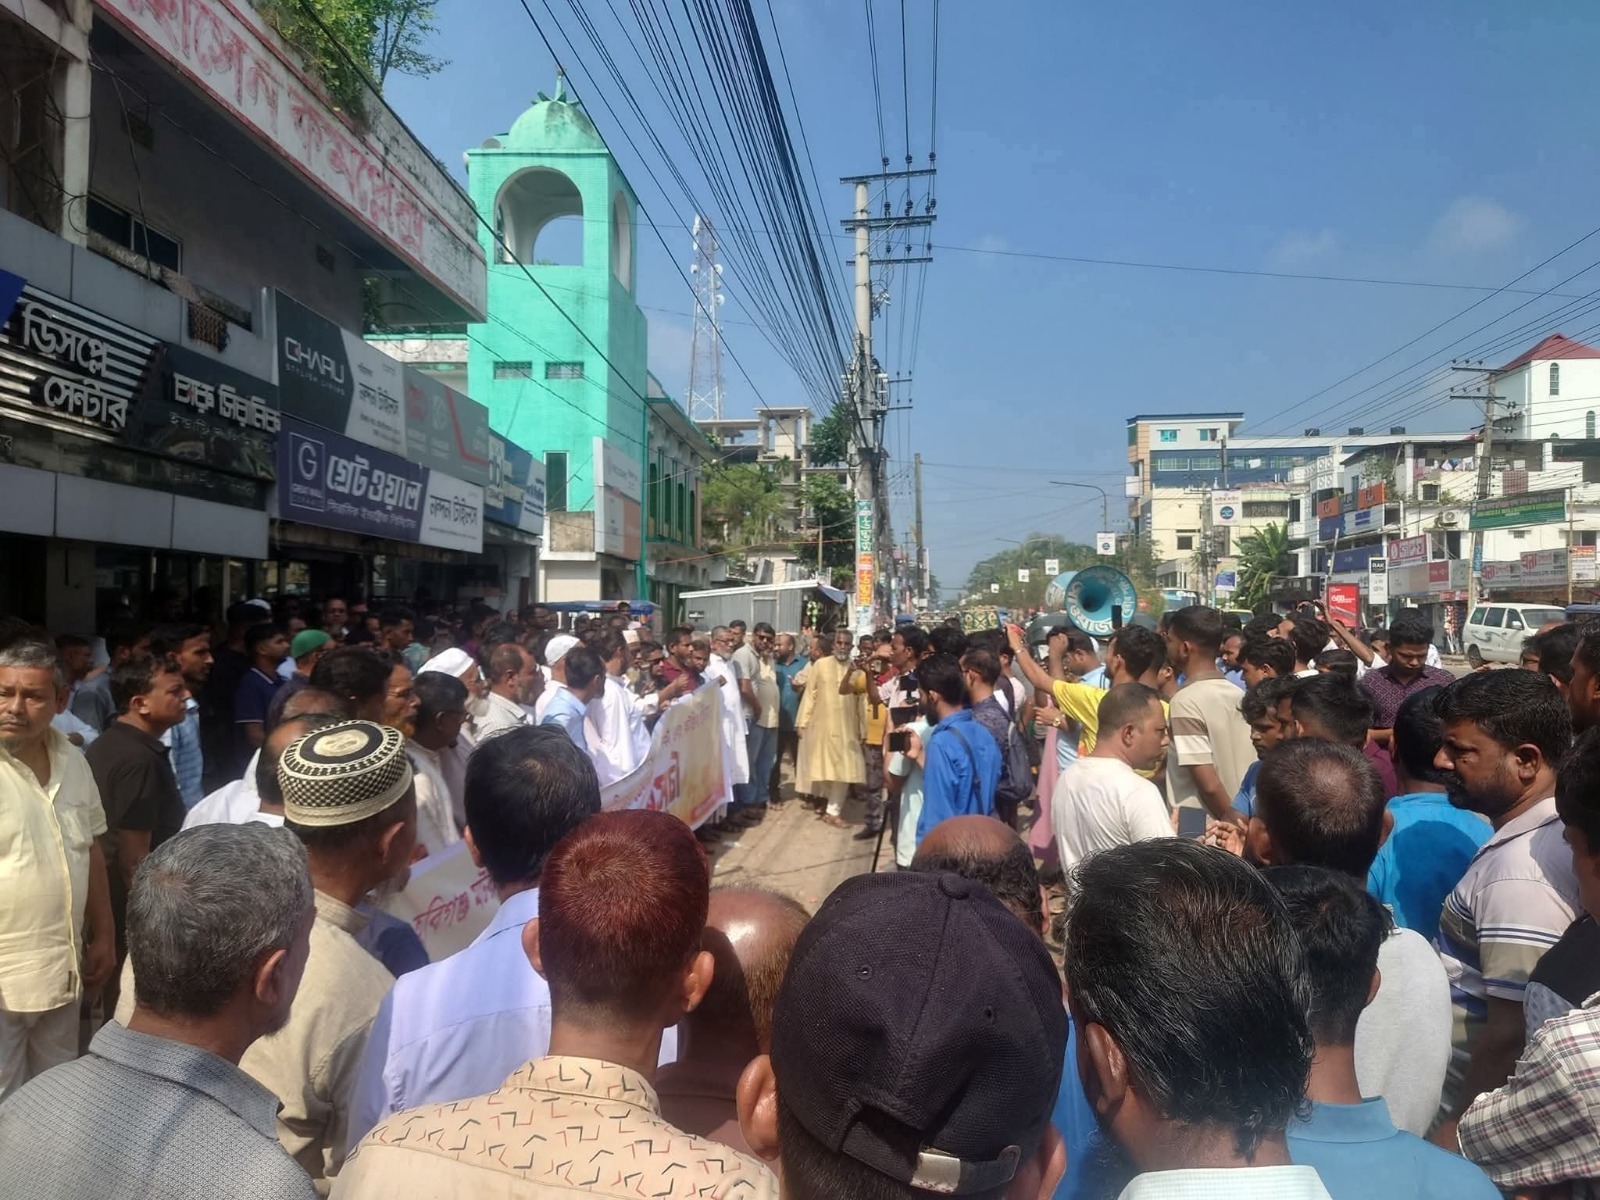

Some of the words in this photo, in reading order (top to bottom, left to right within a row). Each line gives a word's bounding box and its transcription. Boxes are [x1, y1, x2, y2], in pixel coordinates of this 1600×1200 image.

[21, 302, 107, 377] ডিসপ্লে
[285, 337, 345, 384] CHARU
[43, 375, 129, 430] সেন্টার
[326, 454, 370, 497] গ্রেট
[367, 469, 423, 512] ওয়াল
